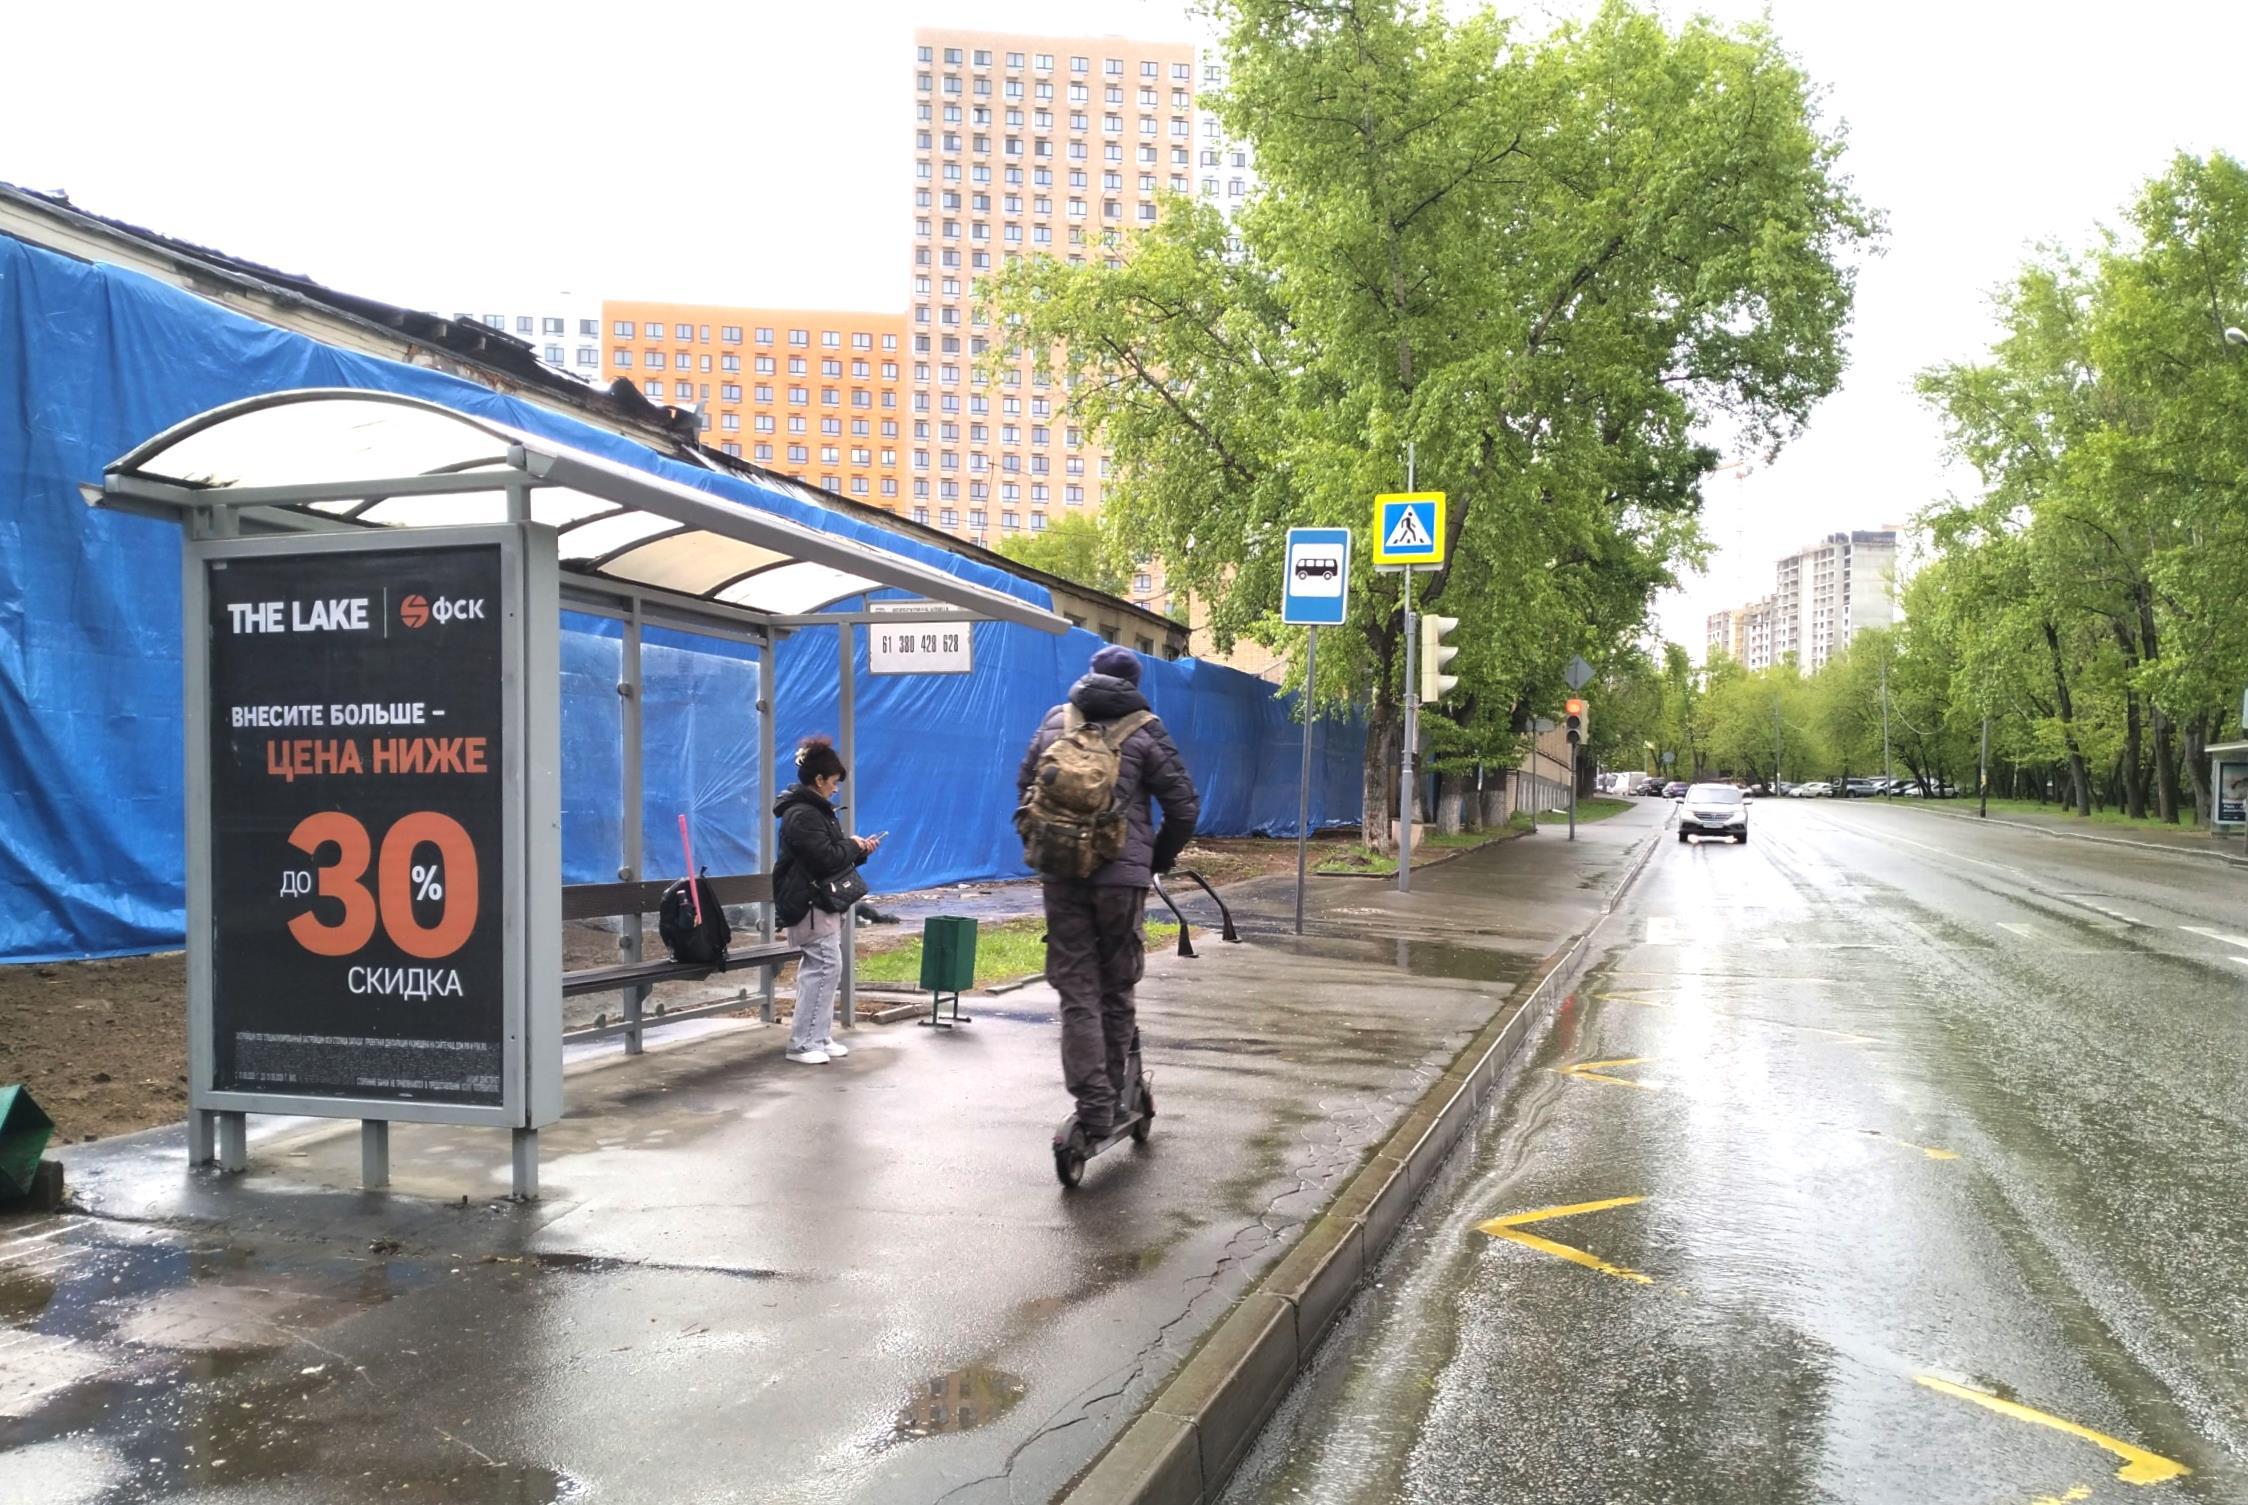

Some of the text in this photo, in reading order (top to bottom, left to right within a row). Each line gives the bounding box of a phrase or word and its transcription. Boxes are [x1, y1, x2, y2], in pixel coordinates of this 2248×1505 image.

[228, 598, 369, 634] THE LAKE
[882, 635, 892, 653] 61
[899, 634, 915, 653] 380
[231, 705, 324, 728] ВНЕСИТЕ
[330, 703, 426, 726] БОЛЬШЕ
[267, 737, 488, 783] ЦЕНА НИЖЕ
[280, 871, 311, 898] ДО
[287, 811, 479, 959] 30
[348, 966, 464, 1002] СКИДКА
